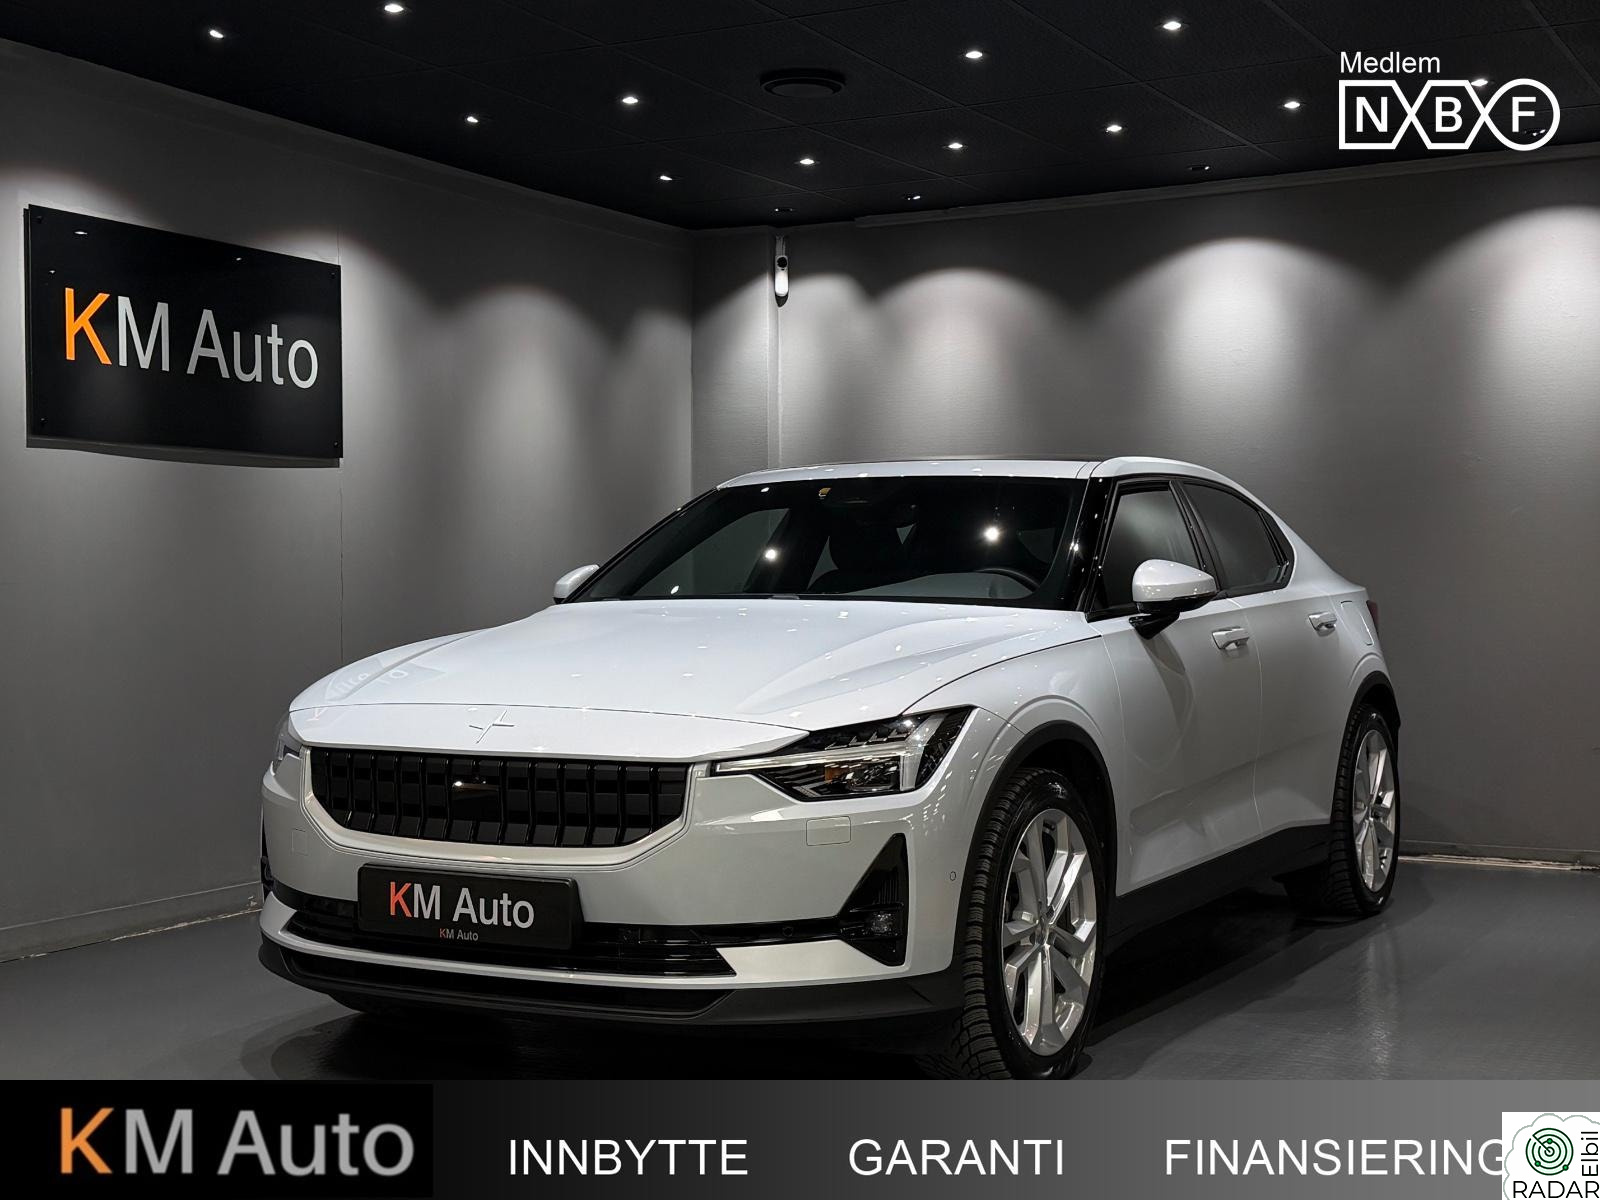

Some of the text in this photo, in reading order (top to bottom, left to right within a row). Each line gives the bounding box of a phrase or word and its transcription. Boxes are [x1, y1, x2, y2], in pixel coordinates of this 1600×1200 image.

[65, 287, 319, 389] KM Auto
[389, 881, 535, 929] KM Auto
[439, 928, 479, 942] KM Auto
